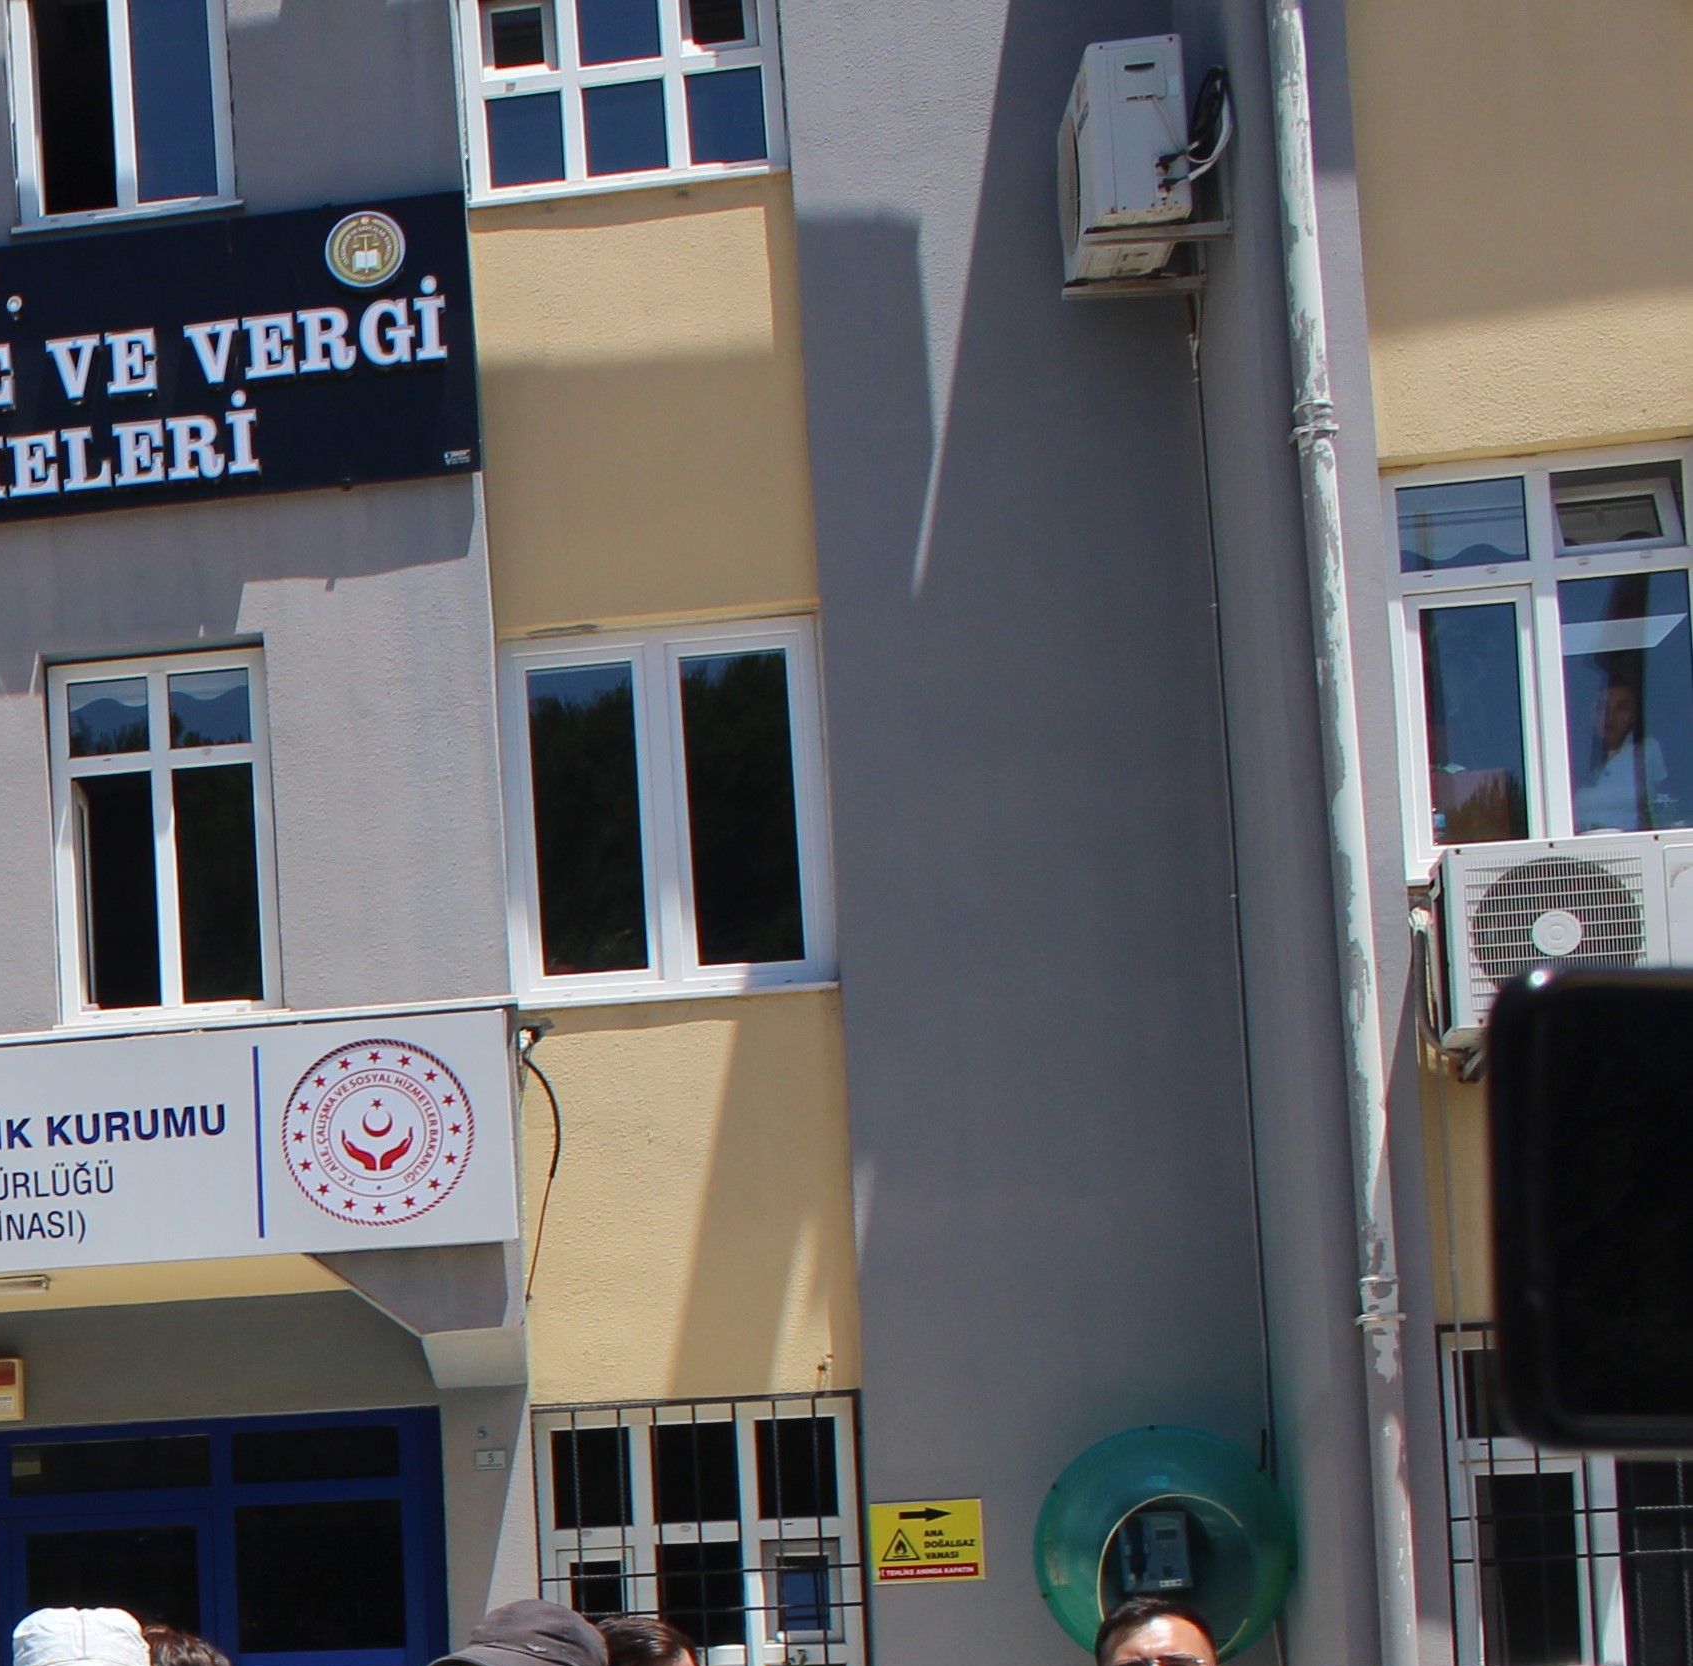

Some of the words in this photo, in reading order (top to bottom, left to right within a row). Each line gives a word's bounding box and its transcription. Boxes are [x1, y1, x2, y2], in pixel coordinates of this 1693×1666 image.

[46, 328, 158, 399] VE
[184, 274, 448, 384] VERGİ
[350, 1073, 392, 1088] SOSYAL
[394, 1076, 438, 1127] HİZMETLER
[46, 1103, 227, 1147] KURUMU
[924, 1538, 976, 1548] DOĞALGAZ
